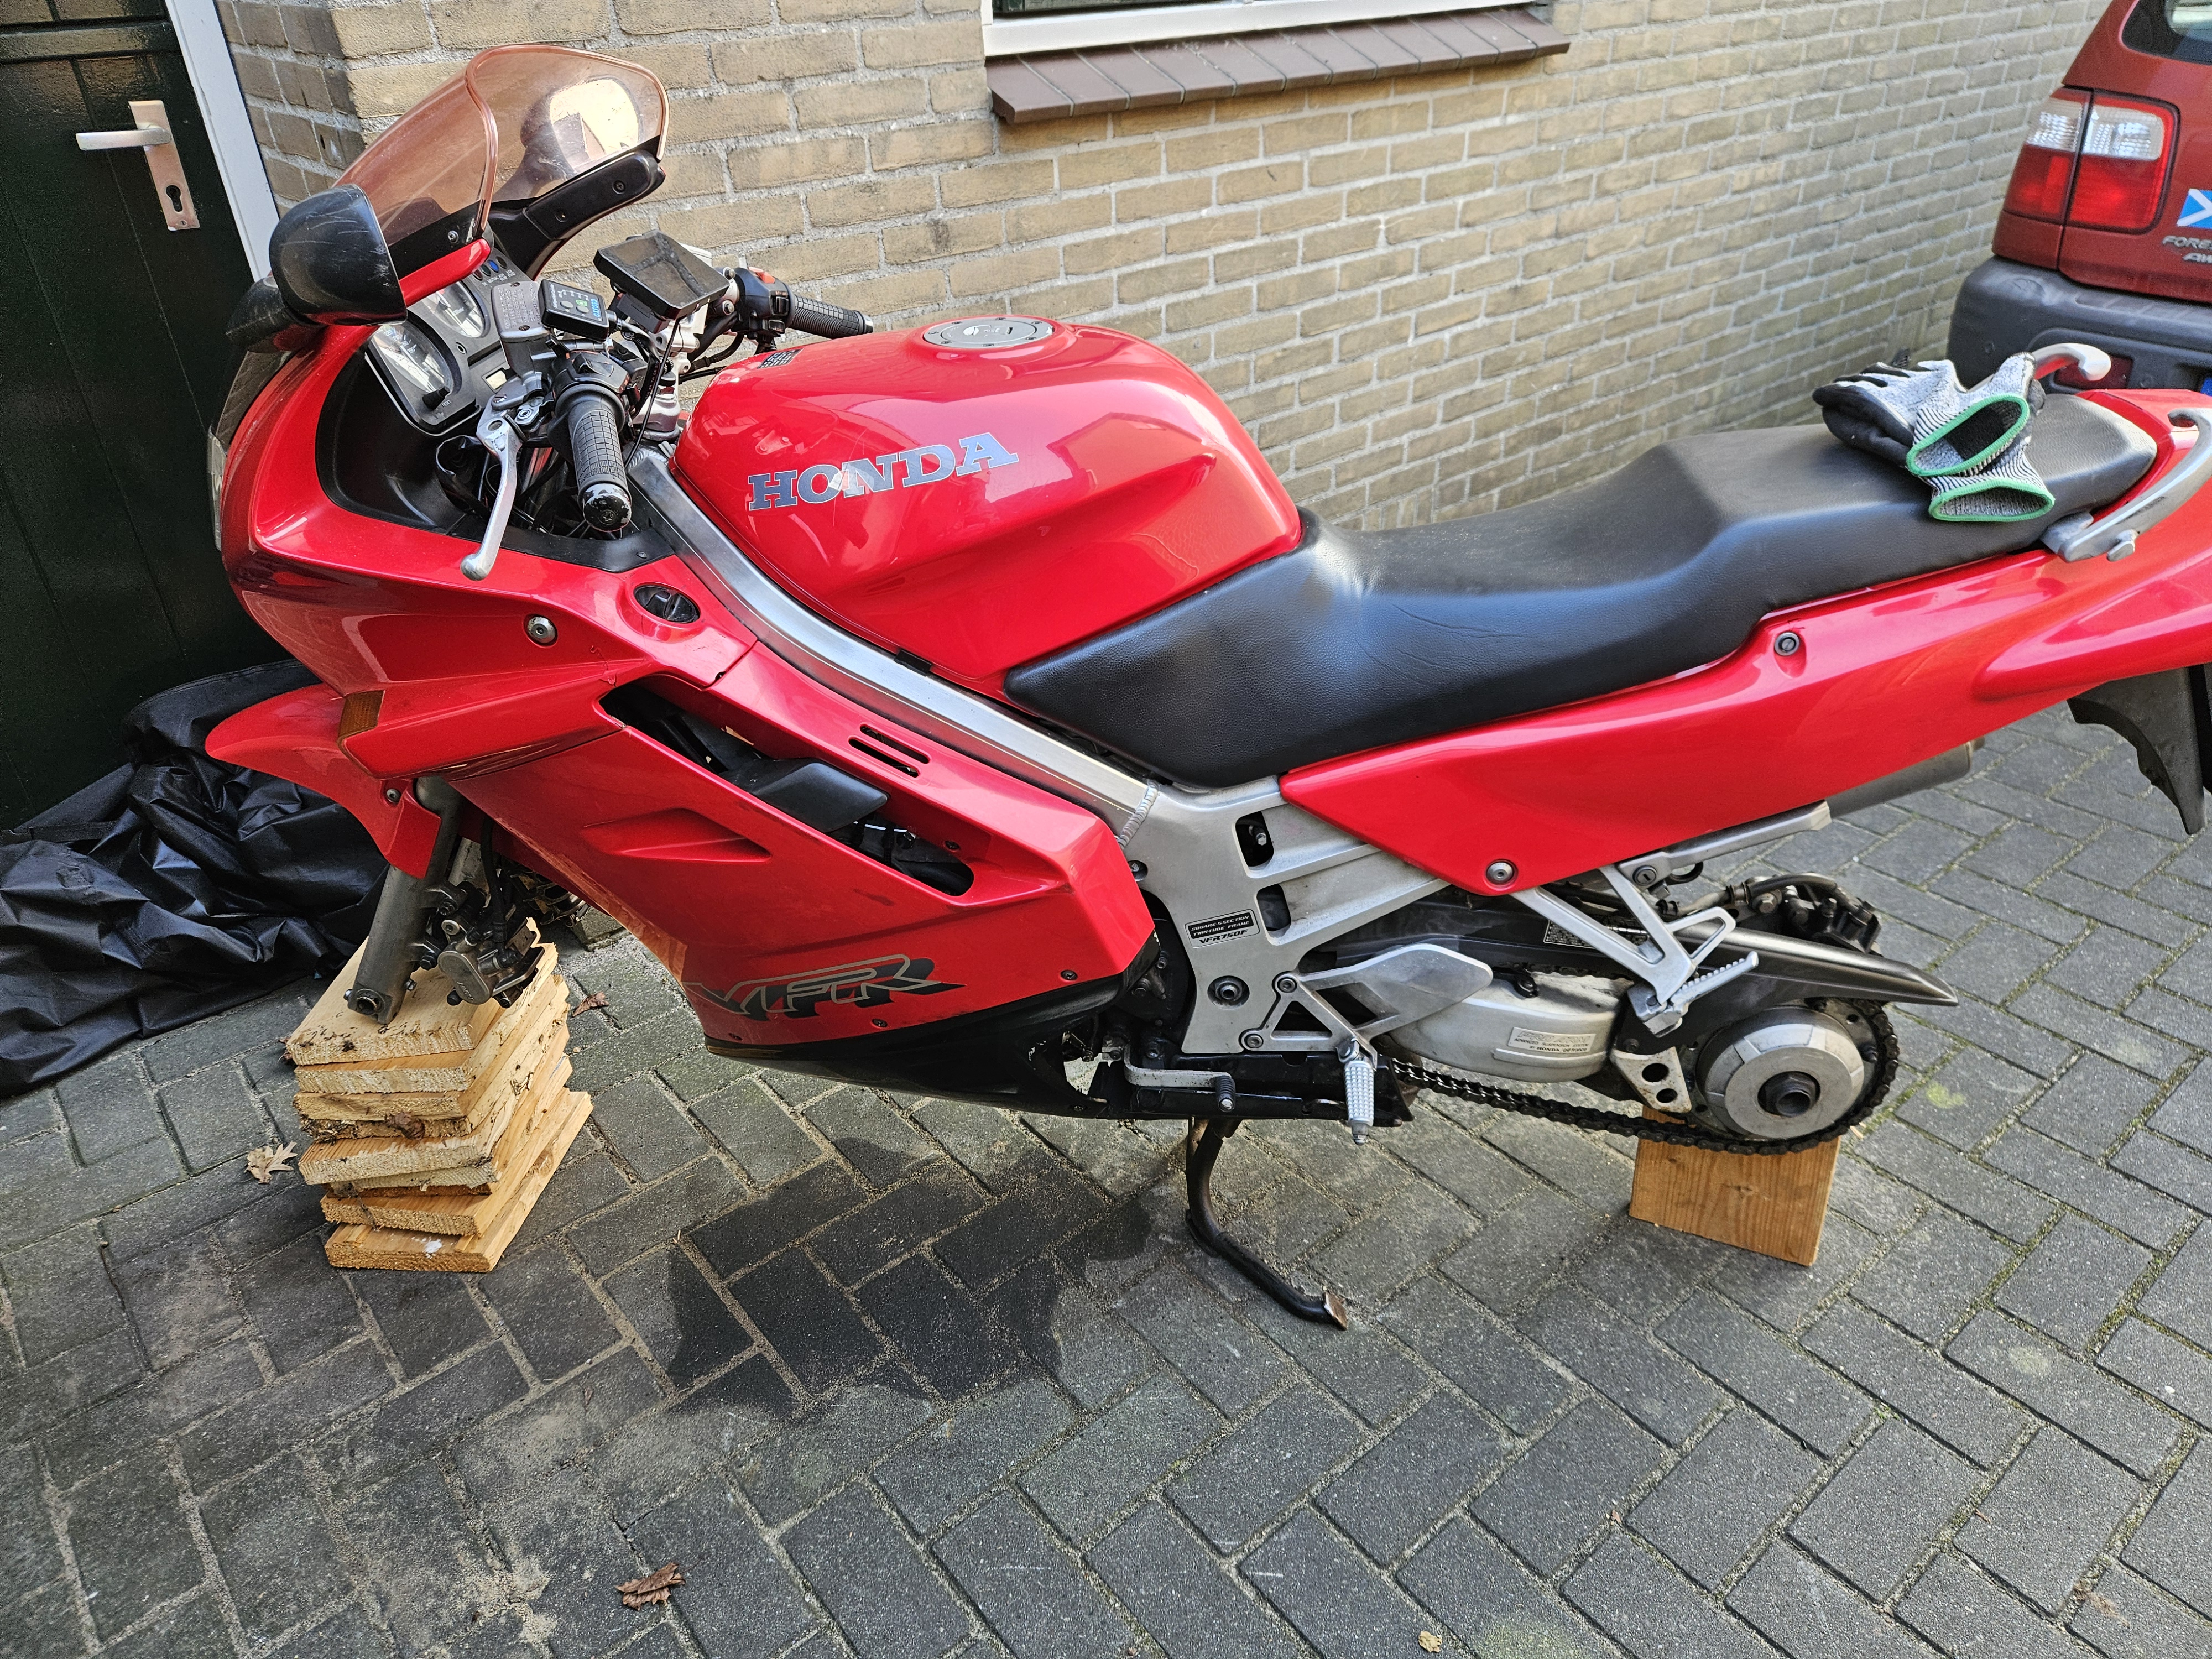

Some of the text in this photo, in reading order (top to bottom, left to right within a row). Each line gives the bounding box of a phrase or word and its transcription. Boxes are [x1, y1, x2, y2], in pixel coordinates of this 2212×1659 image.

[590, 298, 601, 317] OXFORD
[748, 432, 1019, 511] HONDA
[1228, 921, 1250, 929] FRAME
[1199, 929, 1249, 943] VFR750F
[681, 954, 967, 1021] VFR
[1517, 1031, 1555, 1042] PRO
